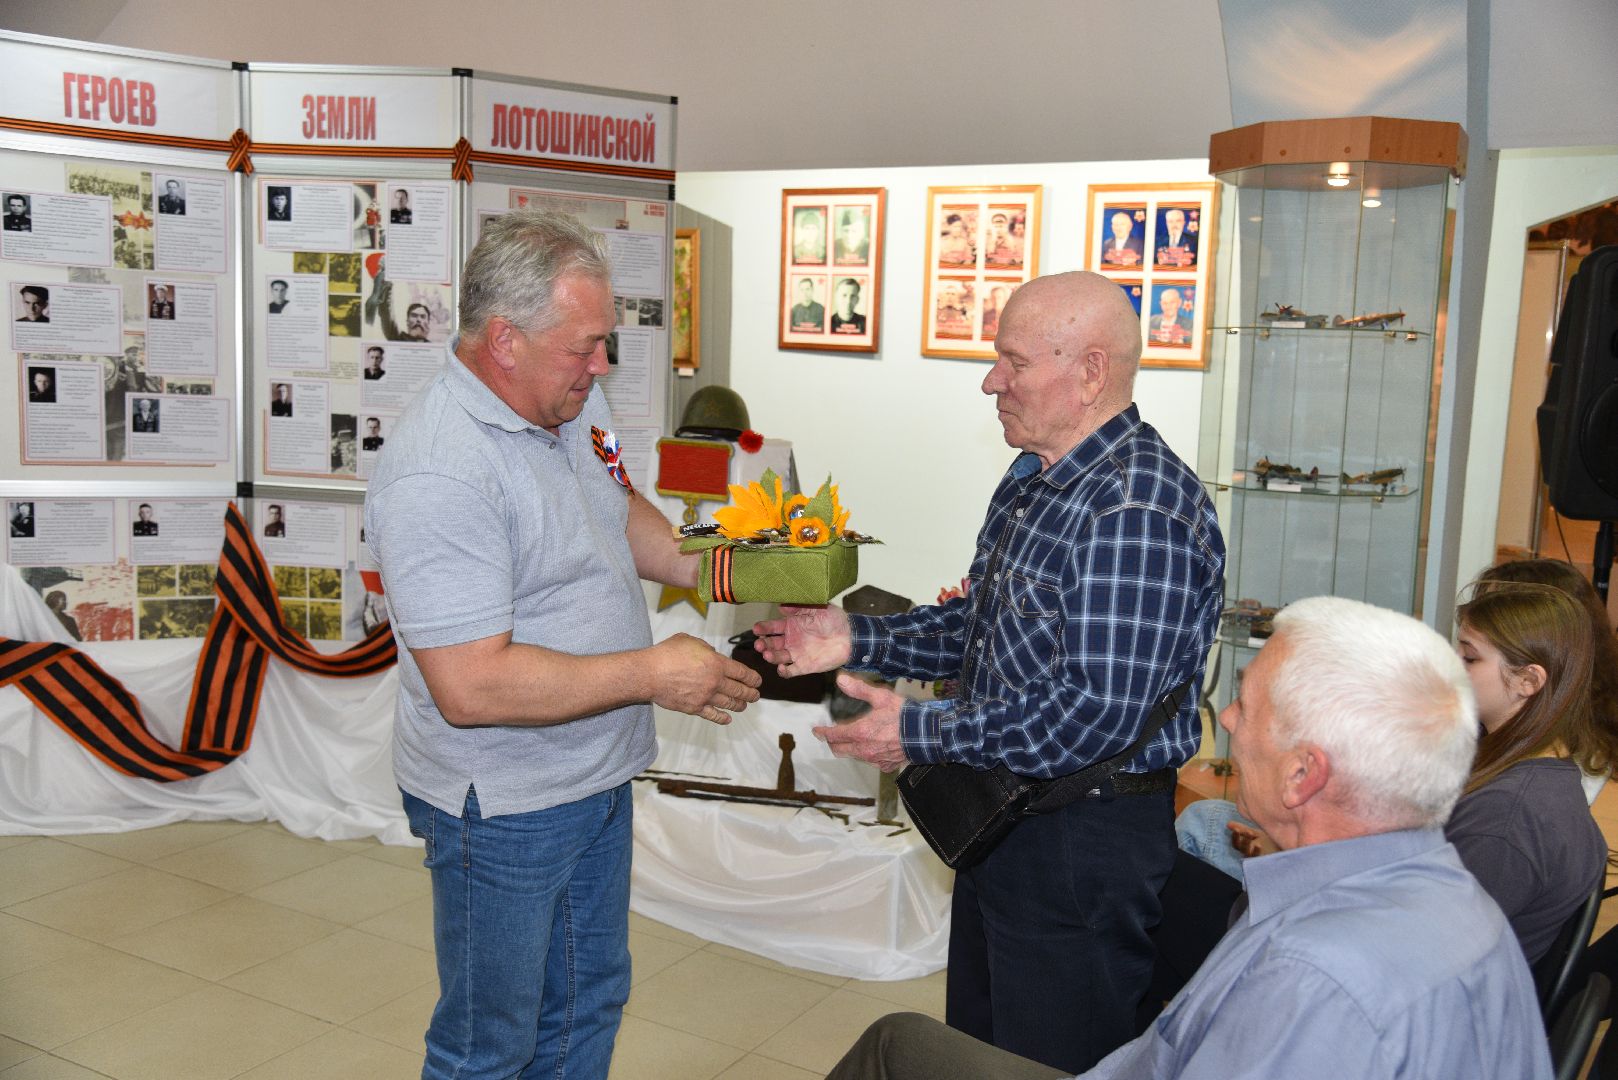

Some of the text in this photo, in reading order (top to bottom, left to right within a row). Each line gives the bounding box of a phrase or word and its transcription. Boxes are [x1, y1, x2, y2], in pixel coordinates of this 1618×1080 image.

[63, 72, 656, 163] ГЕРОЕВ ЗЕМЛИ ЛОТОШИНСКОЙ
